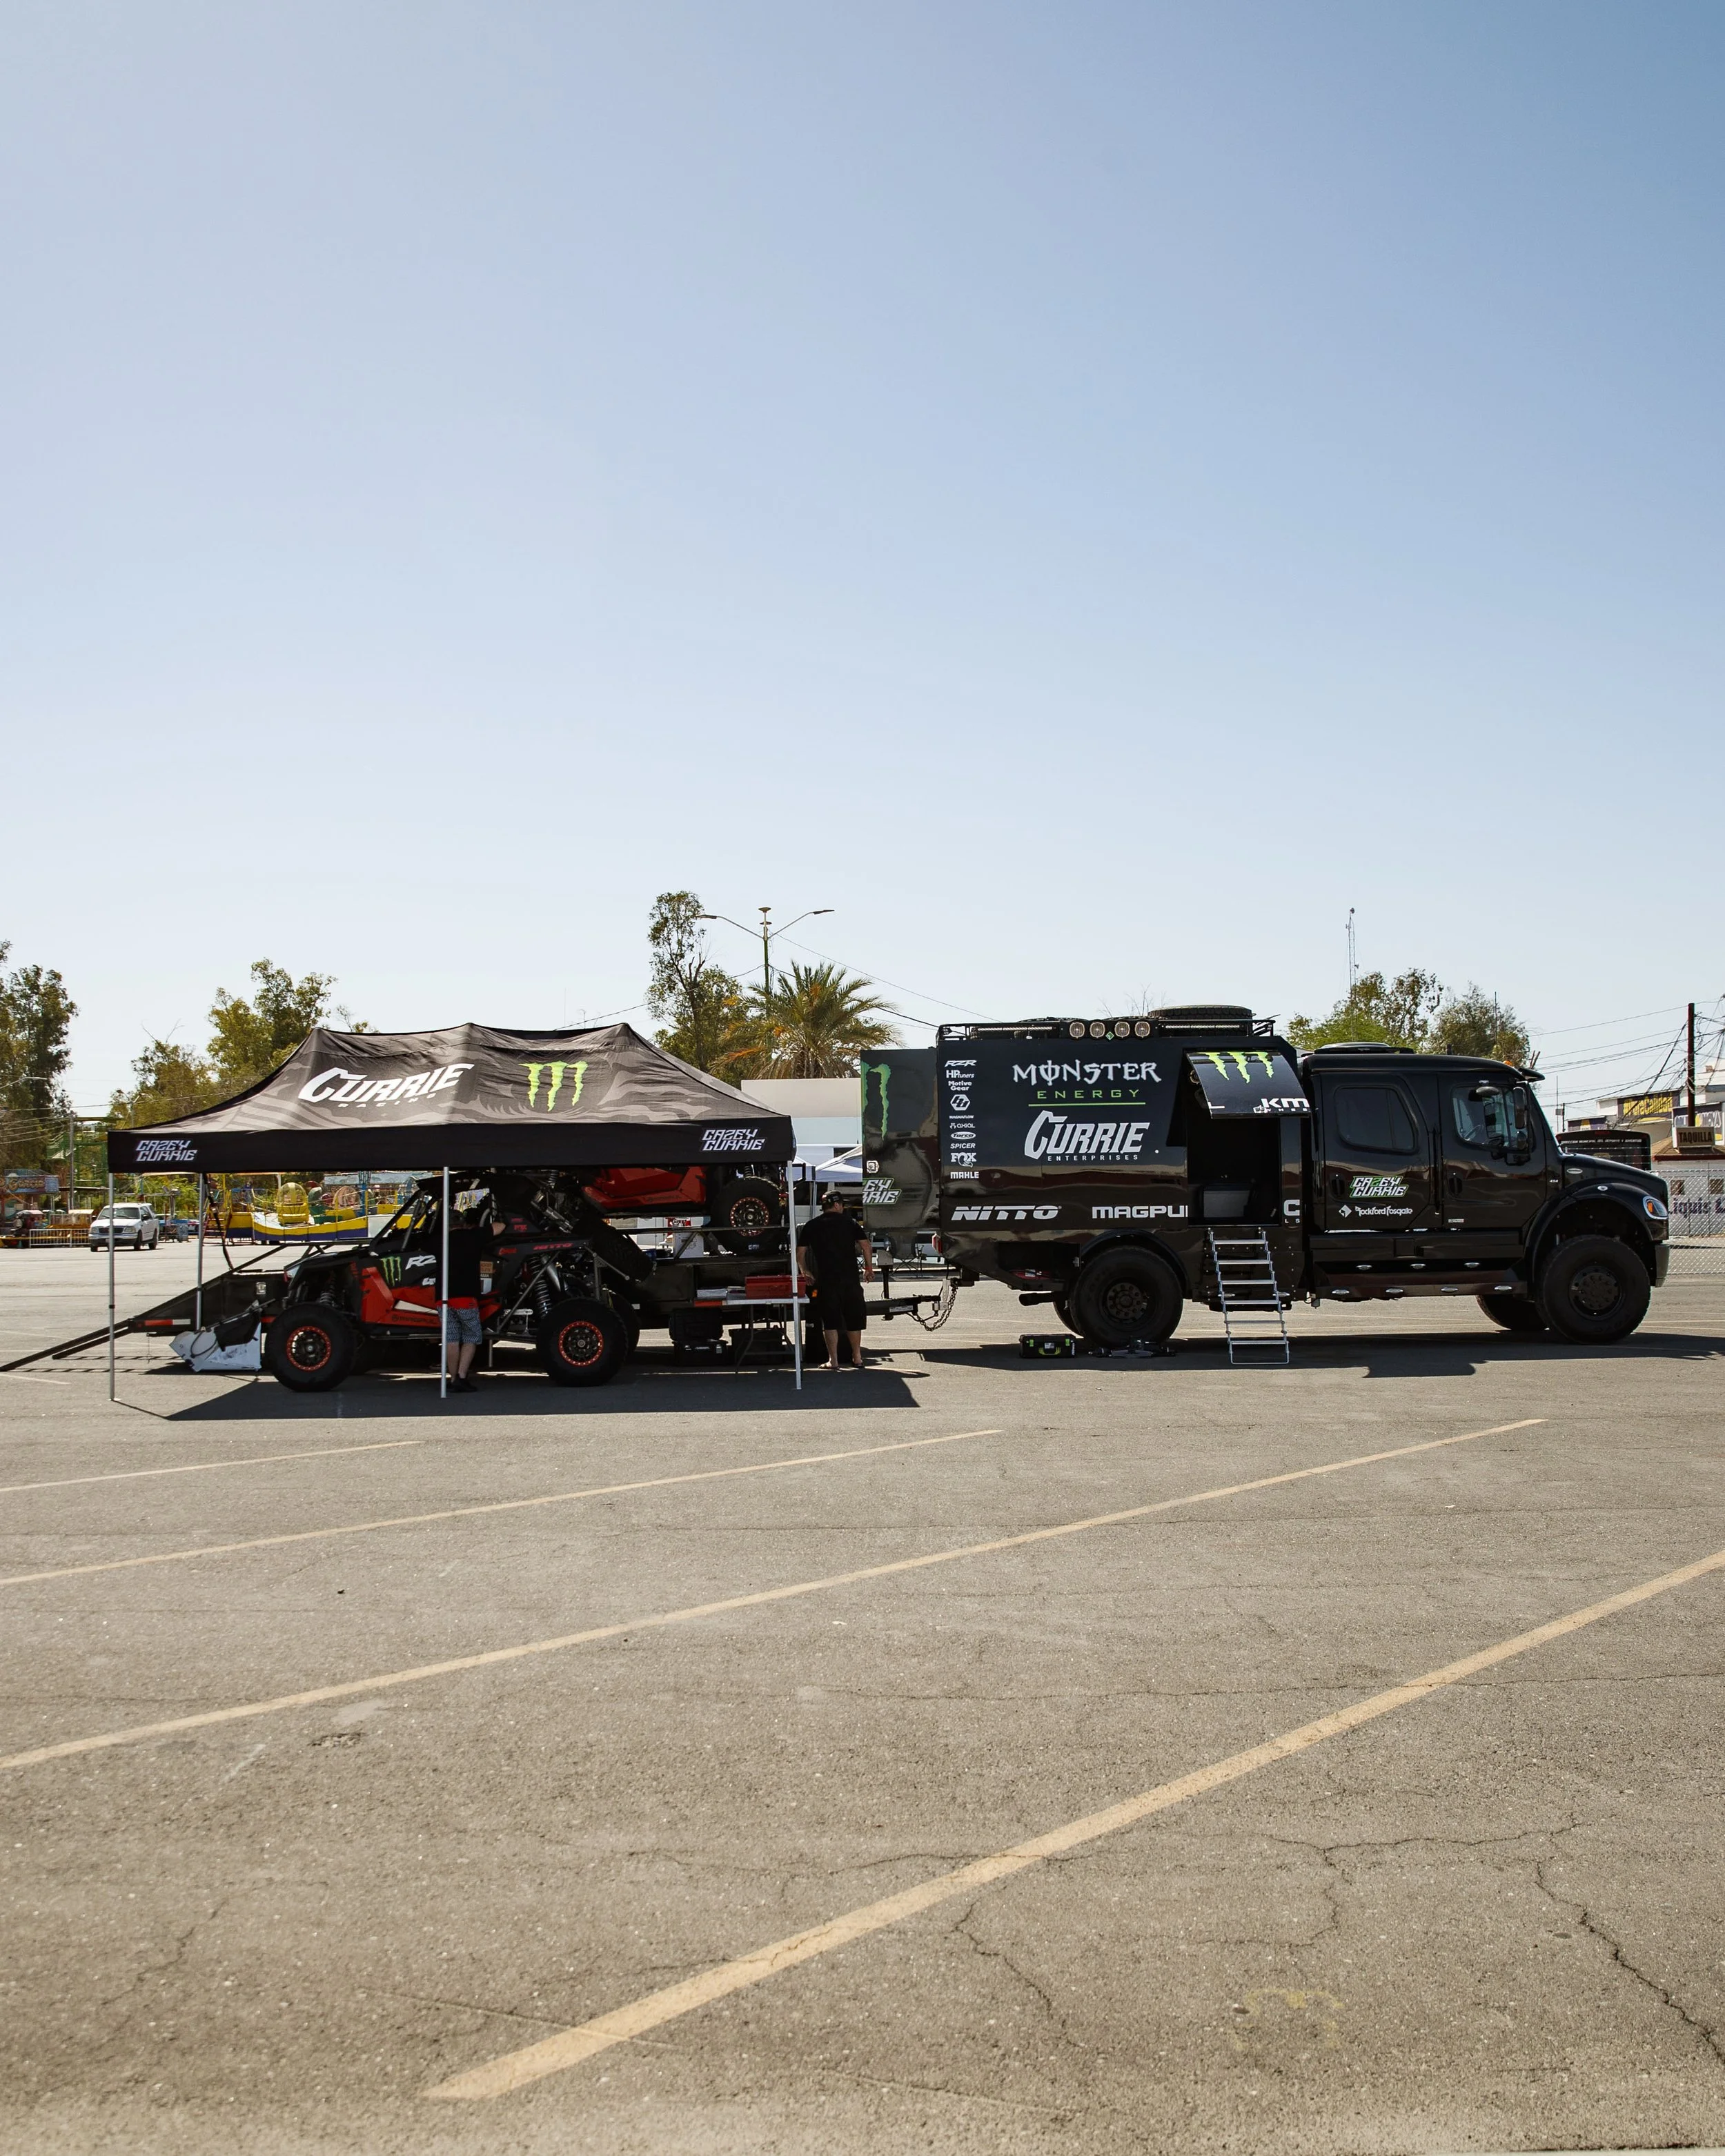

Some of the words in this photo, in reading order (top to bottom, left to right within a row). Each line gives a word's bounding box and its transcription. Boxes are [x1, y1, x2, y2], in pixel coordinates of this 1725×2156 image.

[1012, 1059, 1162, 1086] MONSTER
[298, 1063, 475, 1103] CURRIE
[1037, 1089, 1140, 1099] ENERGY
[1024, 1110, 1151, 1160] CURRIE
[1678, 1131, 1713, 1143] TAQUILLA
[702, 1139, 765, 1151] CURRIE
[137, 1150, 198, 1161] CURRIE
[951, 1152, 976, 1166] FOX
[1352, 1186, 1407, 1197] CURRIE
[952, 1206, 1059, 1220] NITTO
[1355, 1206, 1386, 1217] Rockford
